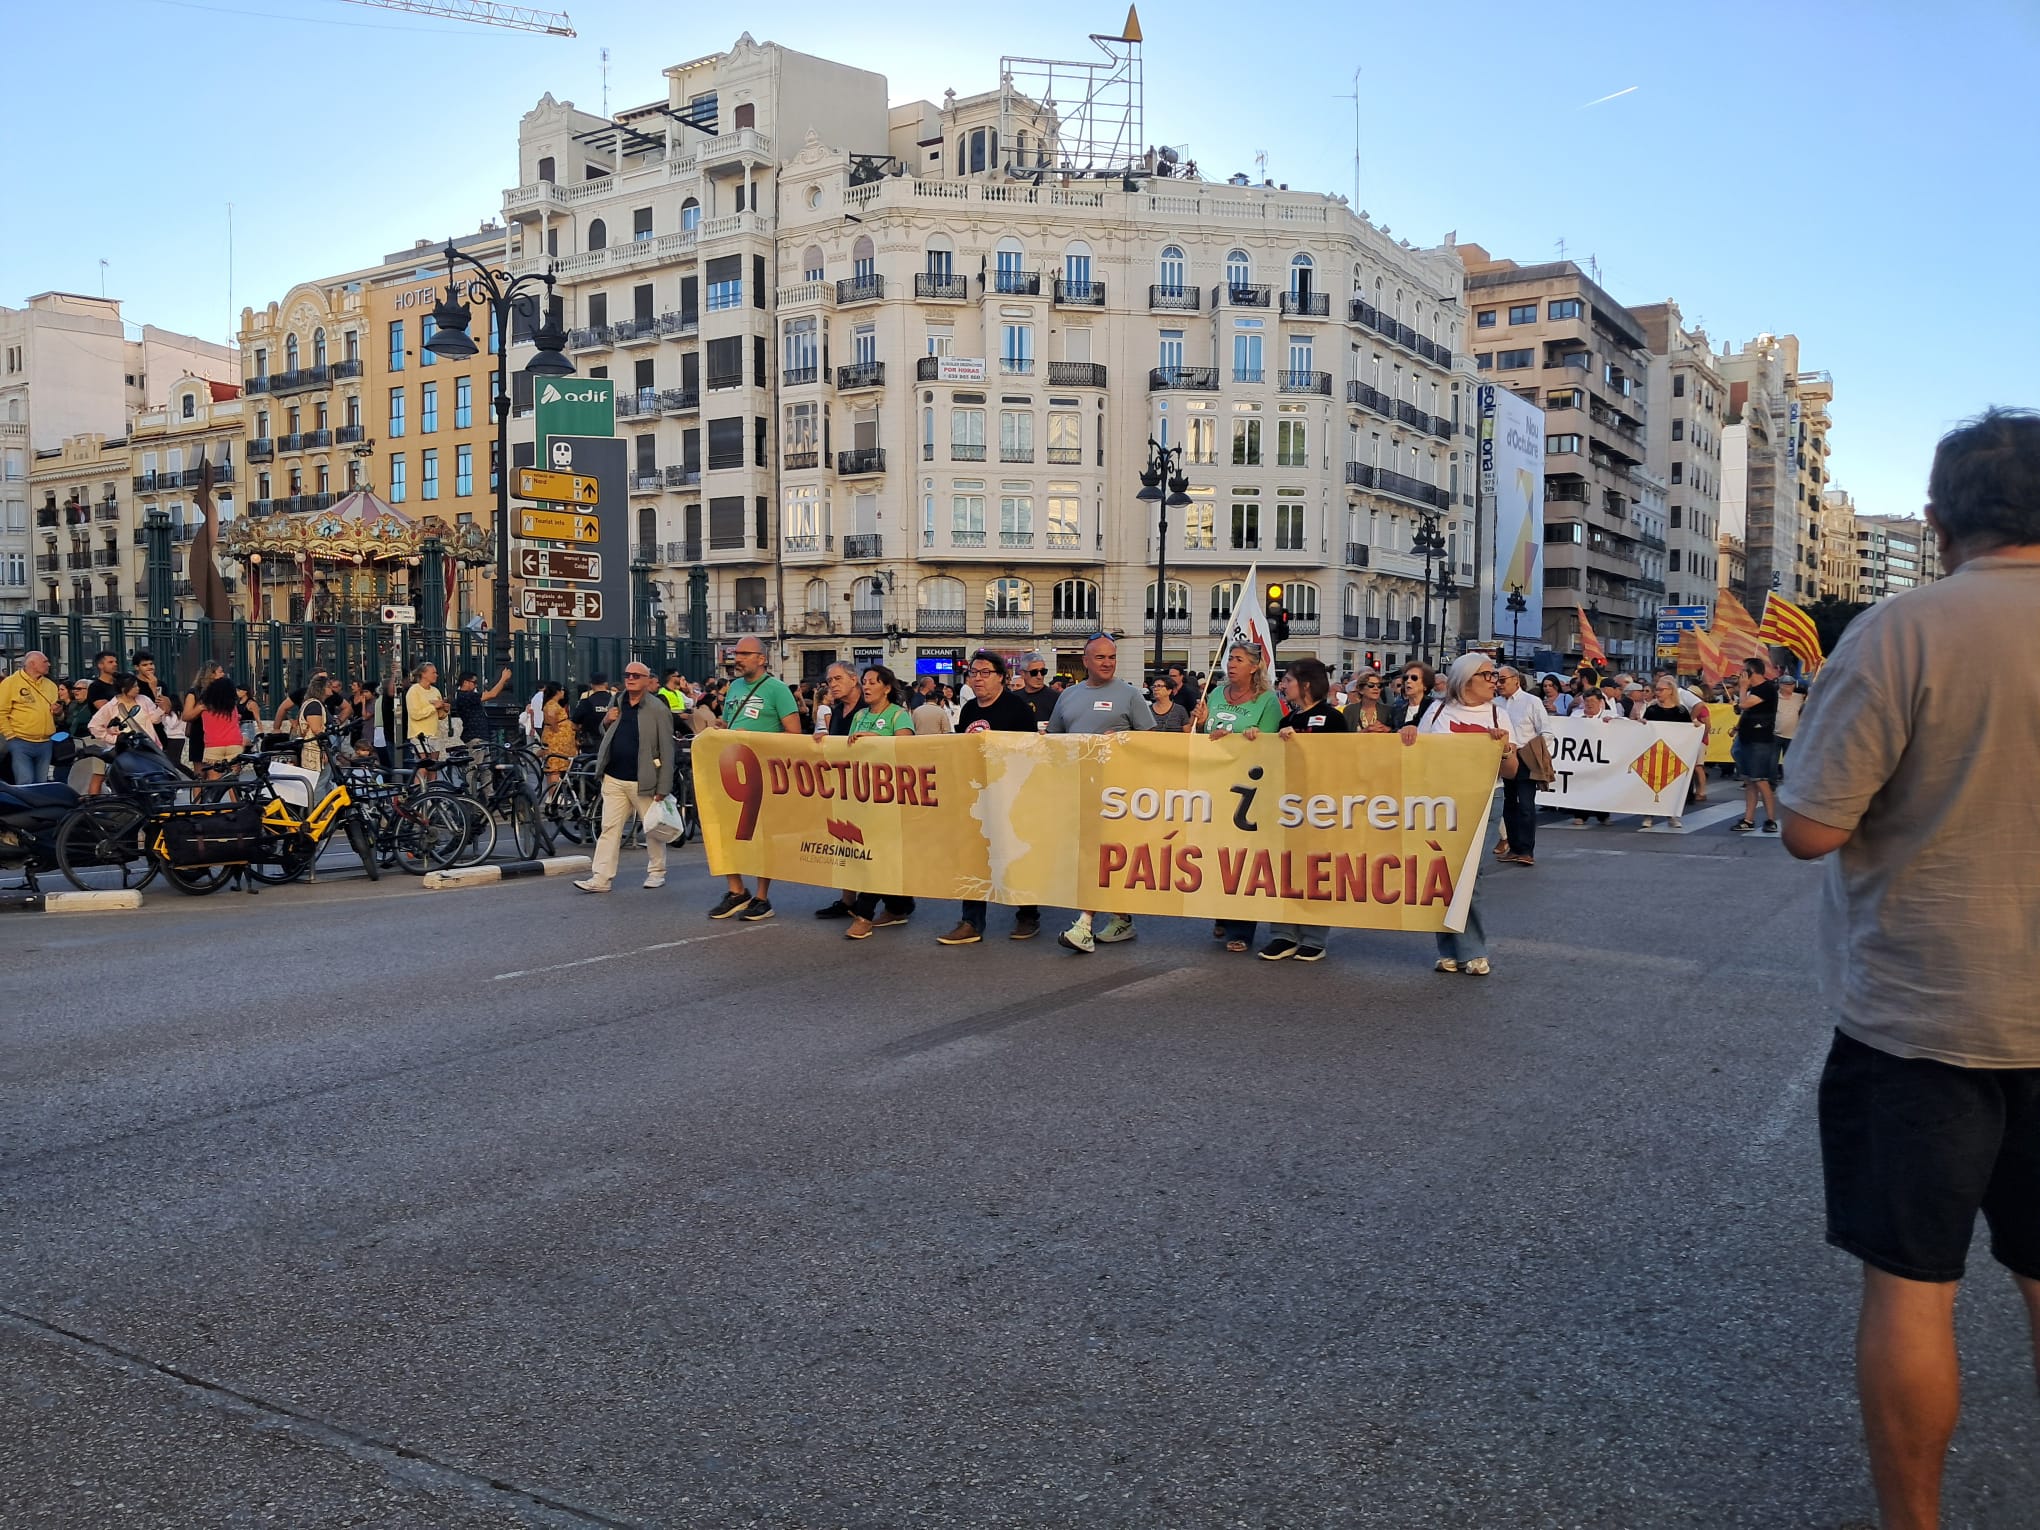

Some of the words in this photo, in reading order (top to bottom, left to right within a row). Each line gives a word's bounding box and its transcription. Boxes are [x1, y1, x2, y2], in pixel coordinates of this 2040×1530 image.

[394, 286, 437, 310] HOTEL
[565, 389, 609, 403] adif
[1525, 416, 1539, 439] Nou
[535, 517, 553, 526] Tourist
[718, 743, 764, 841] 9
[767, 758, 939, 807] D'OCTUBRE
[1100, 786, 1213, 823] som
[1229, 765, 1264, 832] i
[1277, 793, 1458, 831] serem
[800, 841, 873, 861] INTERSINDICAL
[1099, 829, 1203, 893] PAÍS
[1217, 839, 1455, 907] VALENCIÀ
